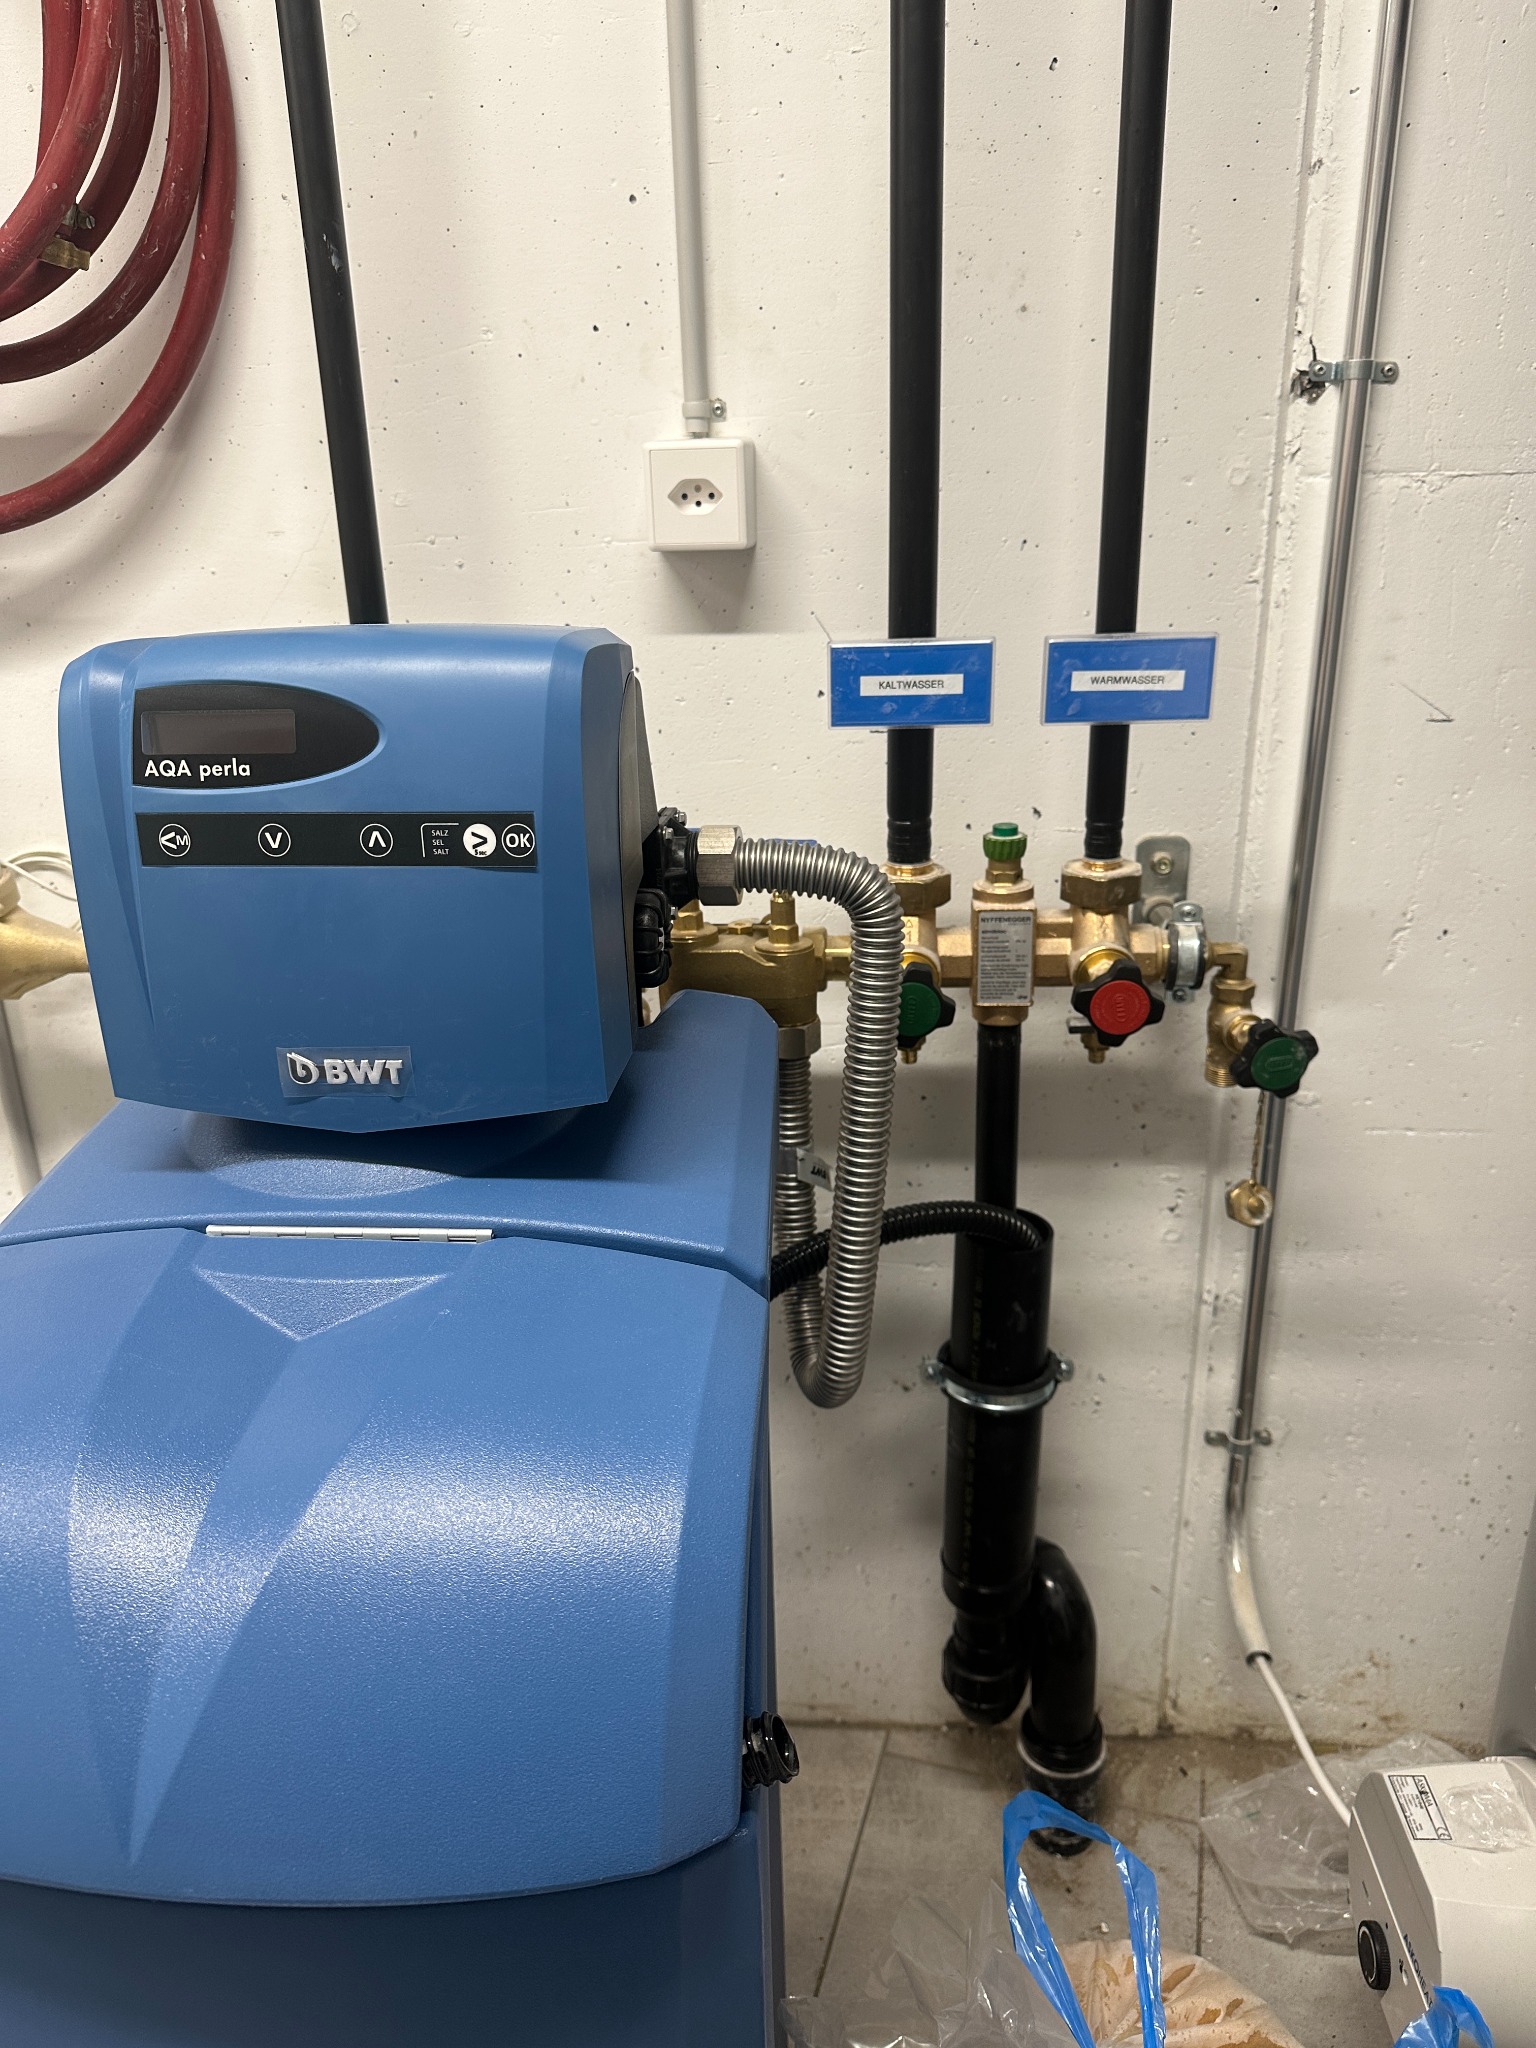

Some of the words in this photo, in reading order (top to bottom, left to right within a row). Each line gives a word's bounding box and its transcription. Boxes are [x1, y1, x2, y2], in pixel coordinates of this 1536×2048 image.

[878, 679, 945, 691] KALTWASSER
[1090, 674, 1165, 686] WARMWASSER
[144, 759, 192, 777] AQA
[199, 757, 251, 781] perla
[505, 833, 531, 848] OK
[323, 1058, 403, 1085] BWT
